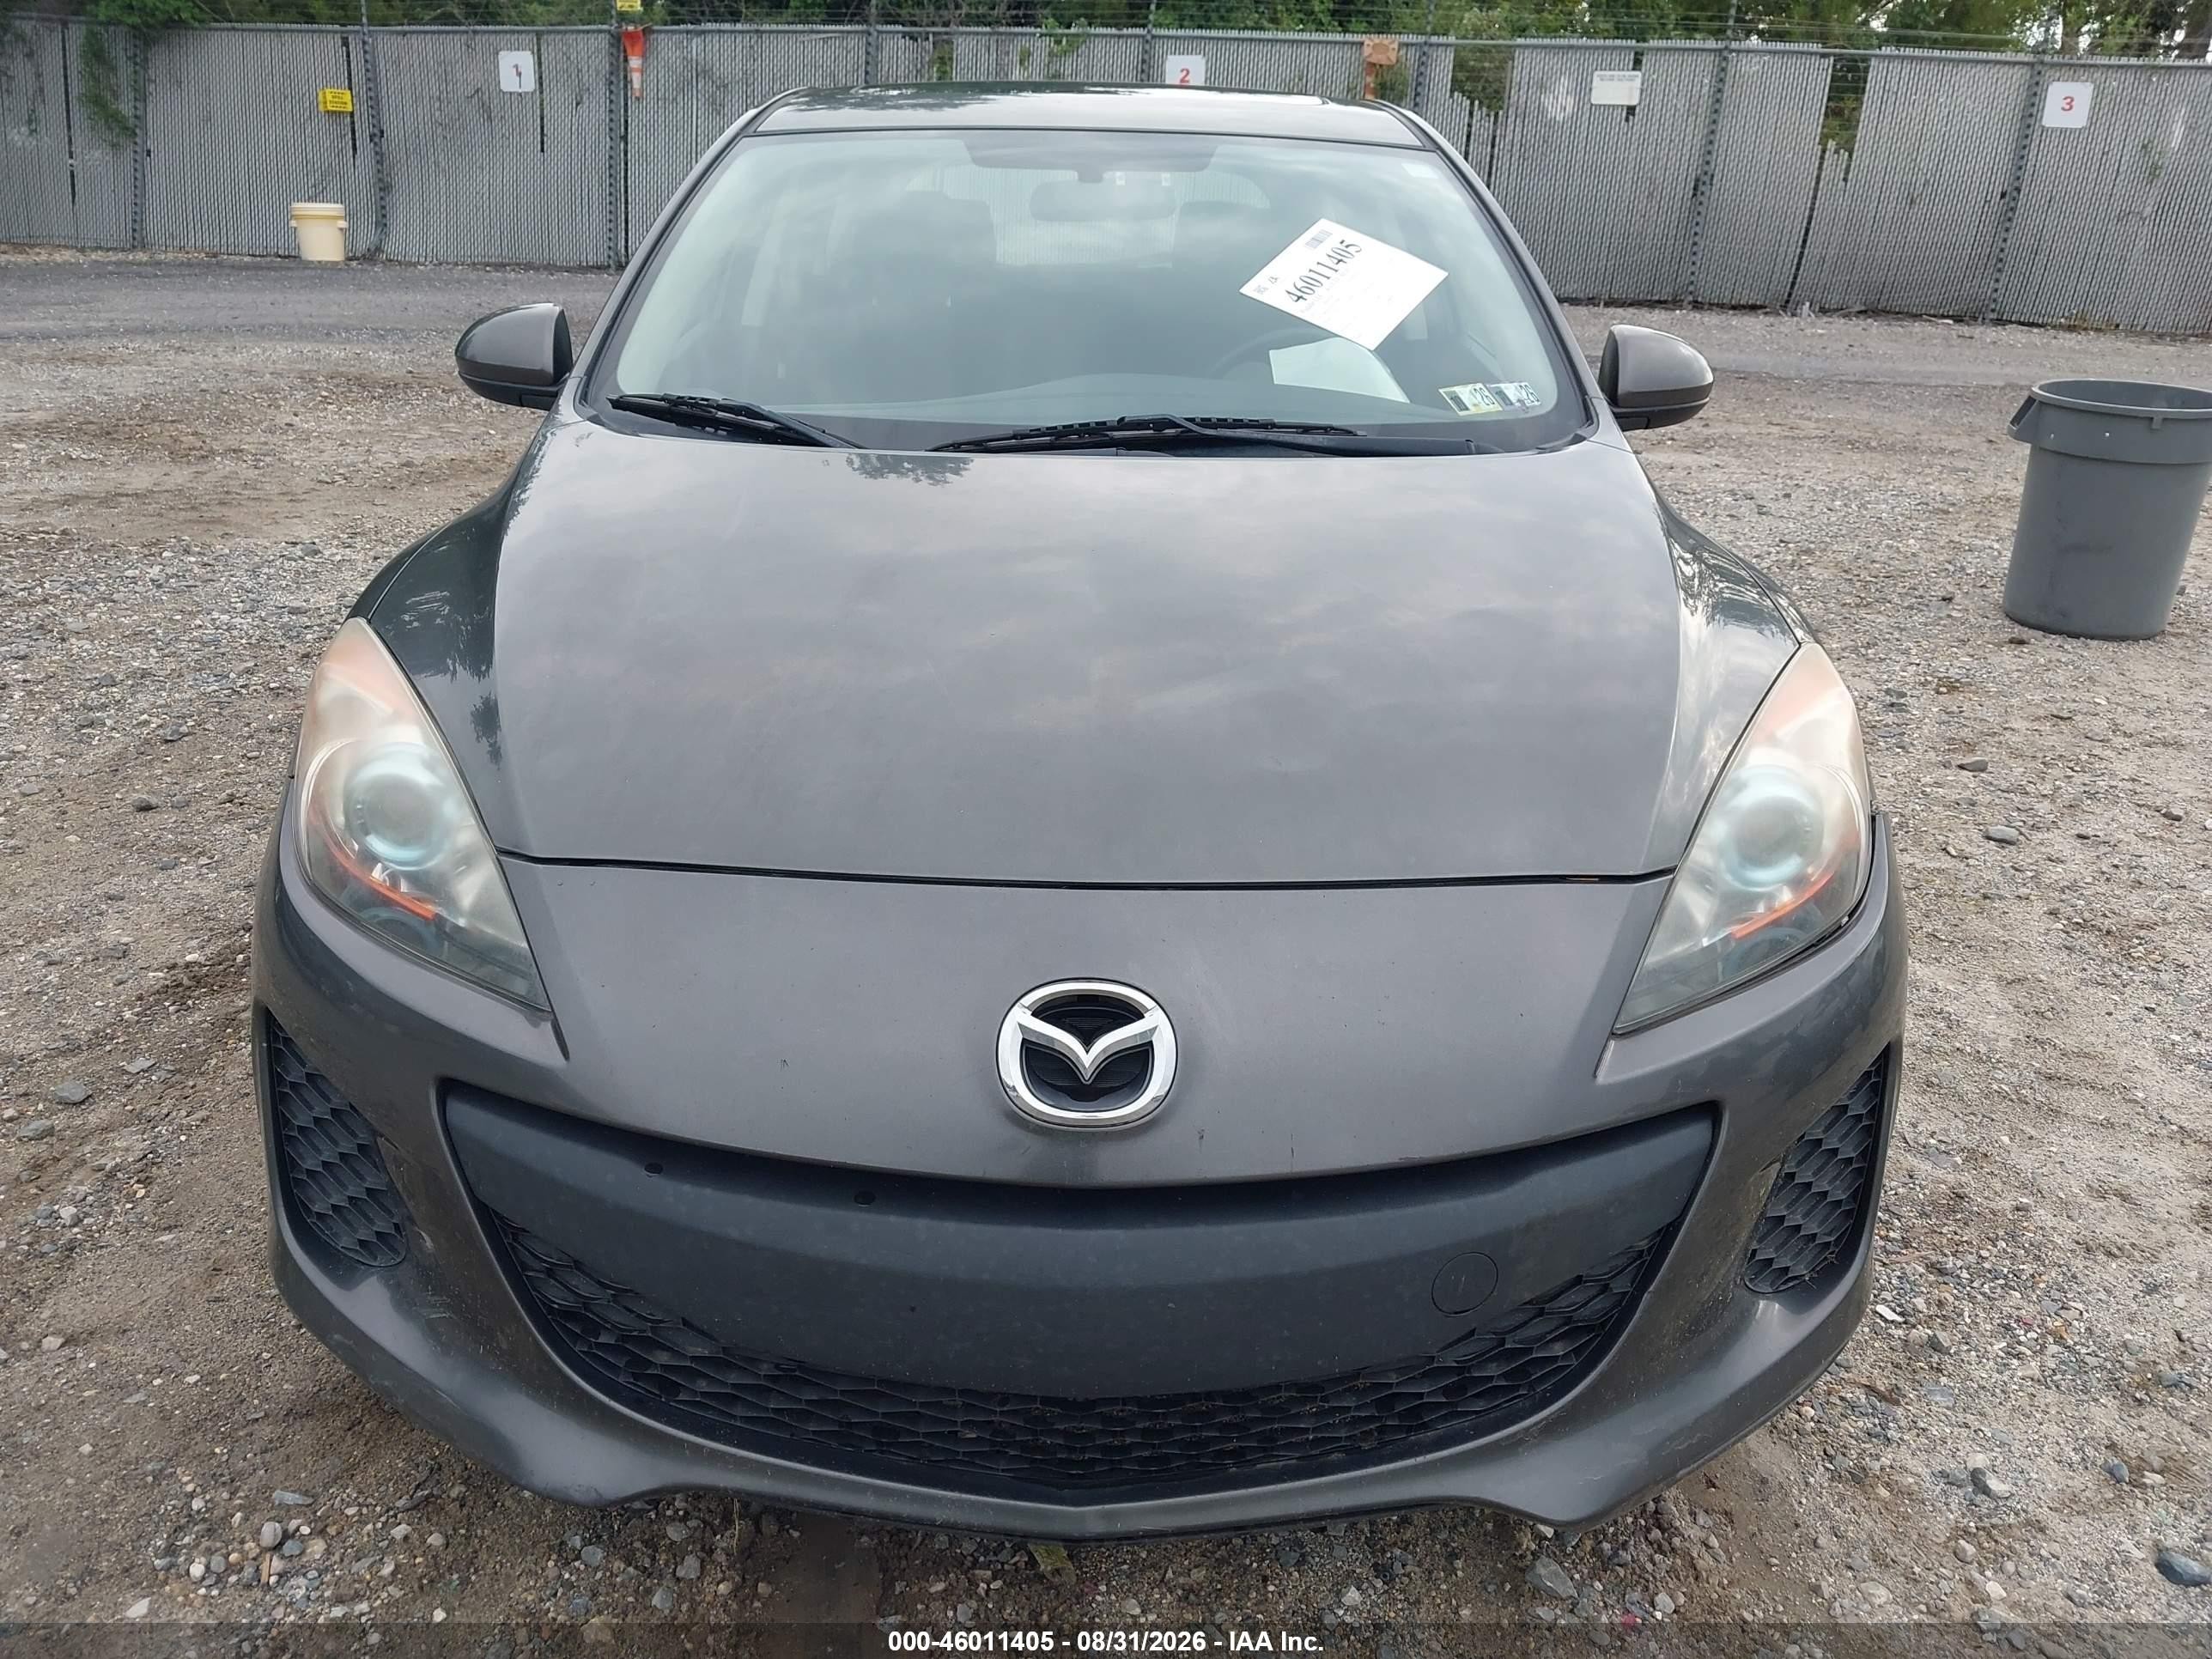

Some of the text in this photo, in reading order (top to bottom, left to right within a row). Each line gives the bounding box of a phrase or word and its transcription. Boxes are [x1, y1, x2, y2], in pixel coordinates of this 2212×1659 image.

[1180, 68, 1190, 83] 2
[2061, 95, 2075, 112] 3
[1285, 239, 1362, 303] 46011405
